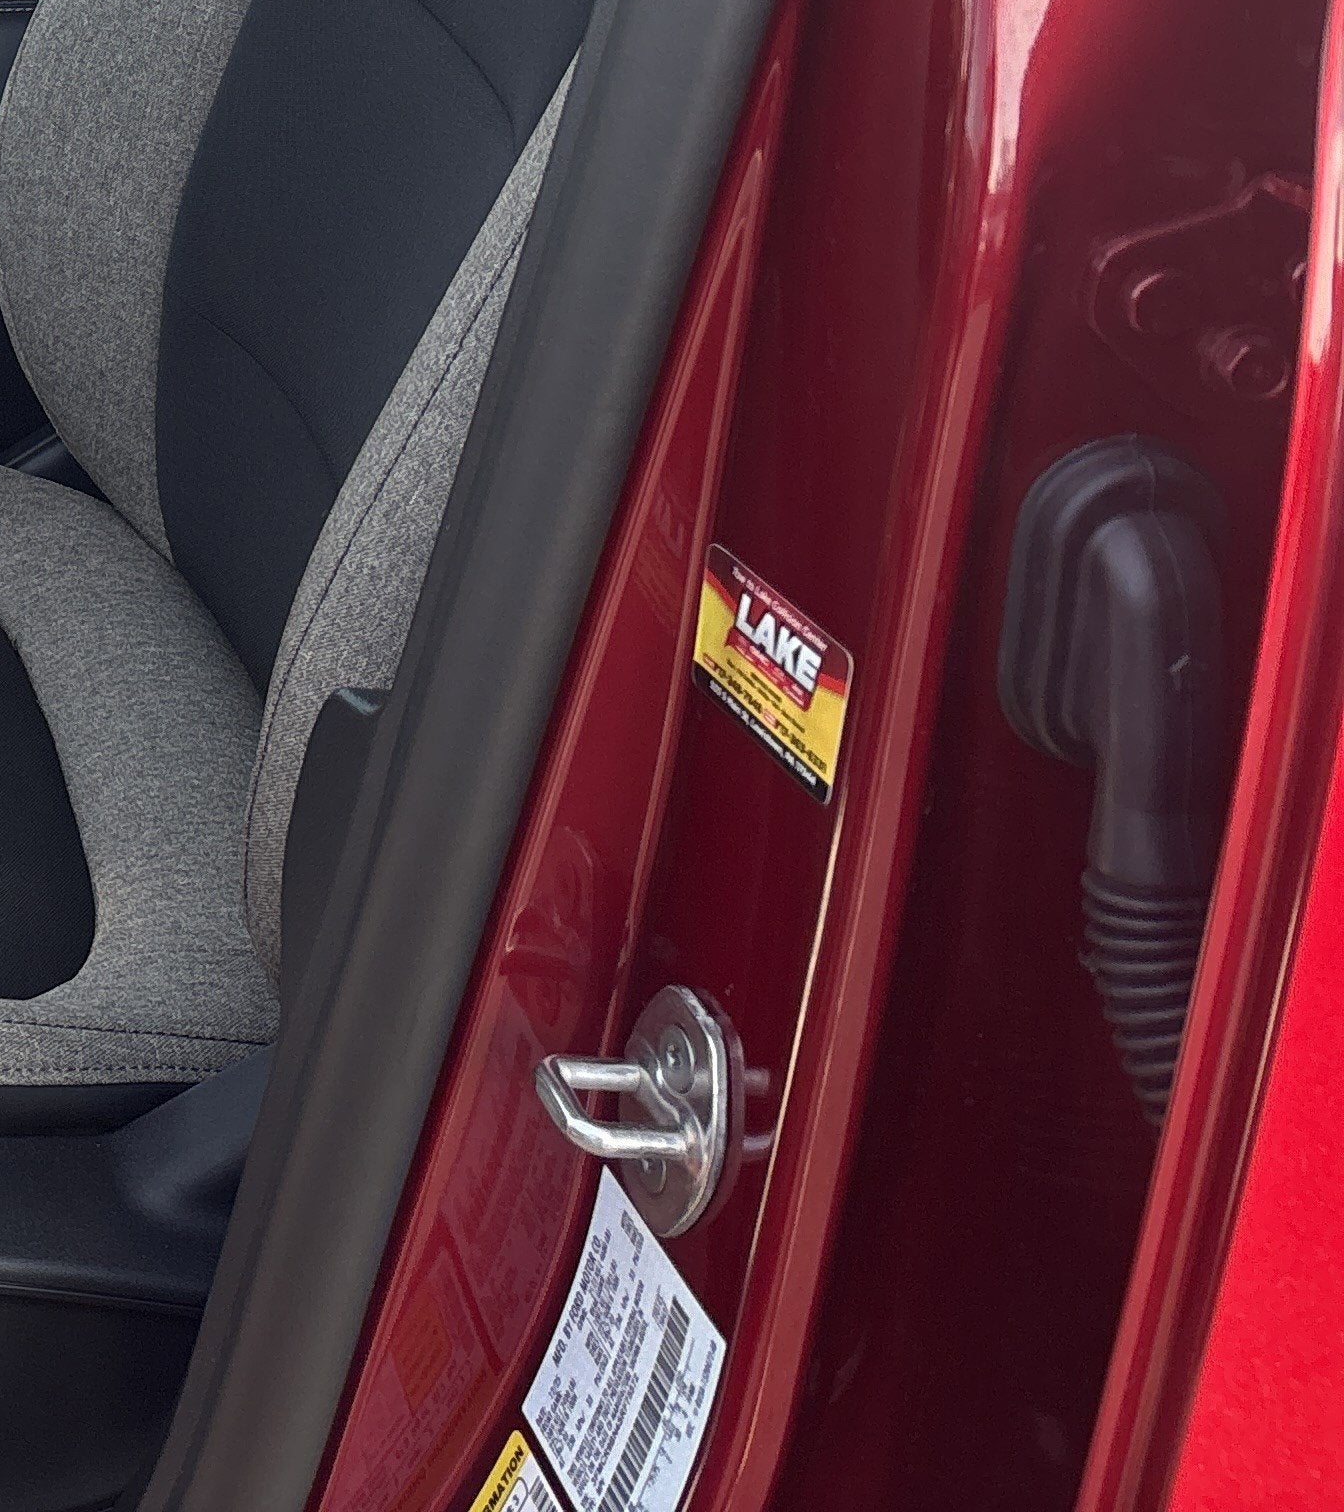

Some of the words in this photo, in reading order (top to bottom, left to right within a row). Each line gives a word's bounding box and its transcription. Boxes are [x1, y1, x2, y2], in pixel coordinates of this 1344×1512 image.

[735, 592, 823, 693] LAKE
[580, 1250, 597, 1291] MOTOR
[568, 1289, 585, 1323] FORD
[563, 1316, 576, 1340] BY
[552, 1338, 568, 1366] MFD.
[481, 1445, 524, 1512] MATION
